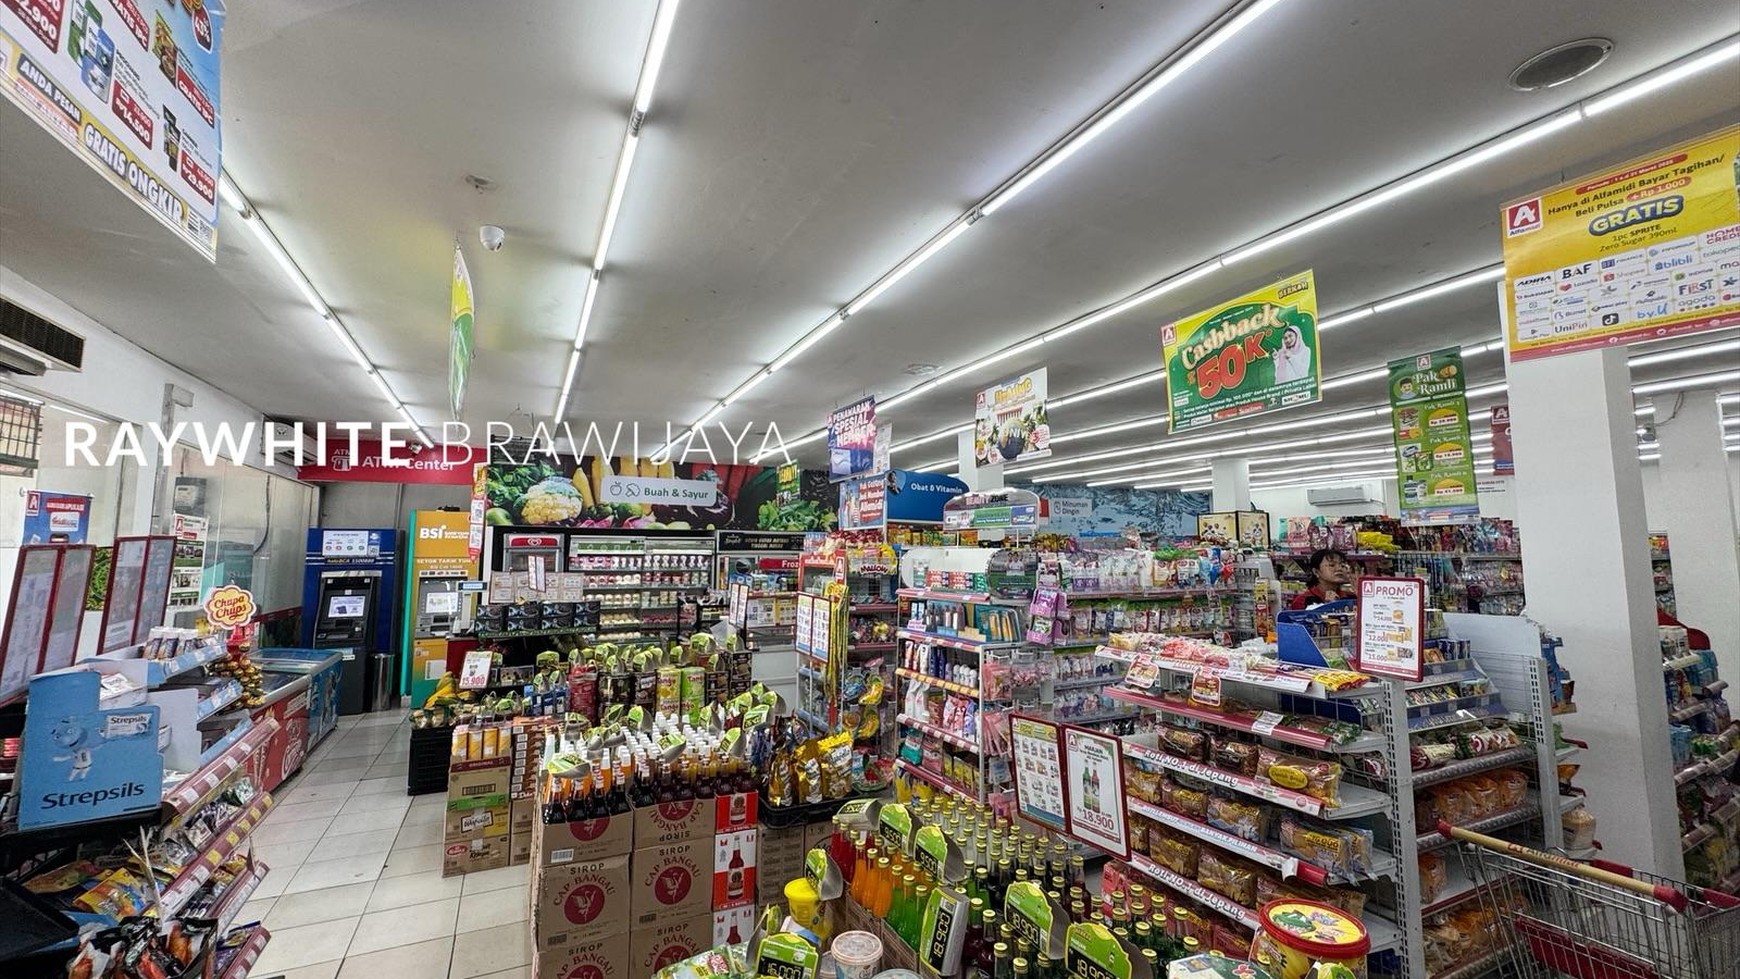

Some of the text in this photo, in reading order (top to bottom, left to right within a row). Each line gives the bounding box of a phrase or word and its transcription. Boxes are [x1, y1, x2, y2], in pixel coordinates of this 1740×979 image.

[20, 60, 53, 97] ANDA
[54, 89, 80, 122] PESAN
[85, 123, 128, 178] GRATIS
[129, 162, 183, 223] ONGKIR
[1548, 153, 1725, 216] Hanya di Alfamidi Bayar Tagihan/
[1575, 206, 1595, 217] Beli
[1596, 197, 1624, 213] Pulsa
[1591, 199, 1681, 233] GRATIS
[1630, 224, 1661, 238] SPRITE
[1599, 243, 1621, 253] Zero
[1621, 236, 1646, 247] Sugar
[1663, 255, 1693, 268] blibli
[1562, 263, 1592, 280] BAF
[1678, 278, 1714, 296] FIRST
[1678, 295, 1716, 306] agoda
[1181, 303, 1286, 370] Cashback
[1414, 369, 1438, 385] Pak
[1418, 379, 1457, 395] Ramli
[835, 413, 869, 436] SPESIAL
[406, 457, 455, 471] Center
[644, 487, 710, 500] Buah & Sayur
[911, 483, 929, 493] Obat
[936, 484, 963, 494] Vitamin
[1062, 501, 1088, 510] Minuman
[1062, 508, 1080, 516] Dingin
[420, 524, 447, 539] BSI
[1376, 585, 1414, 597] PROMO
[214, 594, 245, 611] Chupa
[214, 605, 248, 621] Chups
[110, 715, 147, 724] Strepsils
[1144, 749, 1163, 763] Roti
[1200, 767, 1240, 787] Jepang
[41, 782, 145, 810] Strepsils
[1083, 810, 1114, 831] 18.900
[658, 844, 691, 857] SIROP
[570, 862, 605, 876] SIROP
[644, 855, 702, 888] CAP BANGAU
[553, 873, 616, 907] CAP BANGAU
[1149, 863, 1168, 879] Roti
[1205, 893, 1246, 920] Jepang
[656, 922, 690, 936] SIROP
[568, 942, 604, 956] SIROP
[643, 933, 703, 968] CAP BANGA
[572, 952, 615, 976] BANGAU
